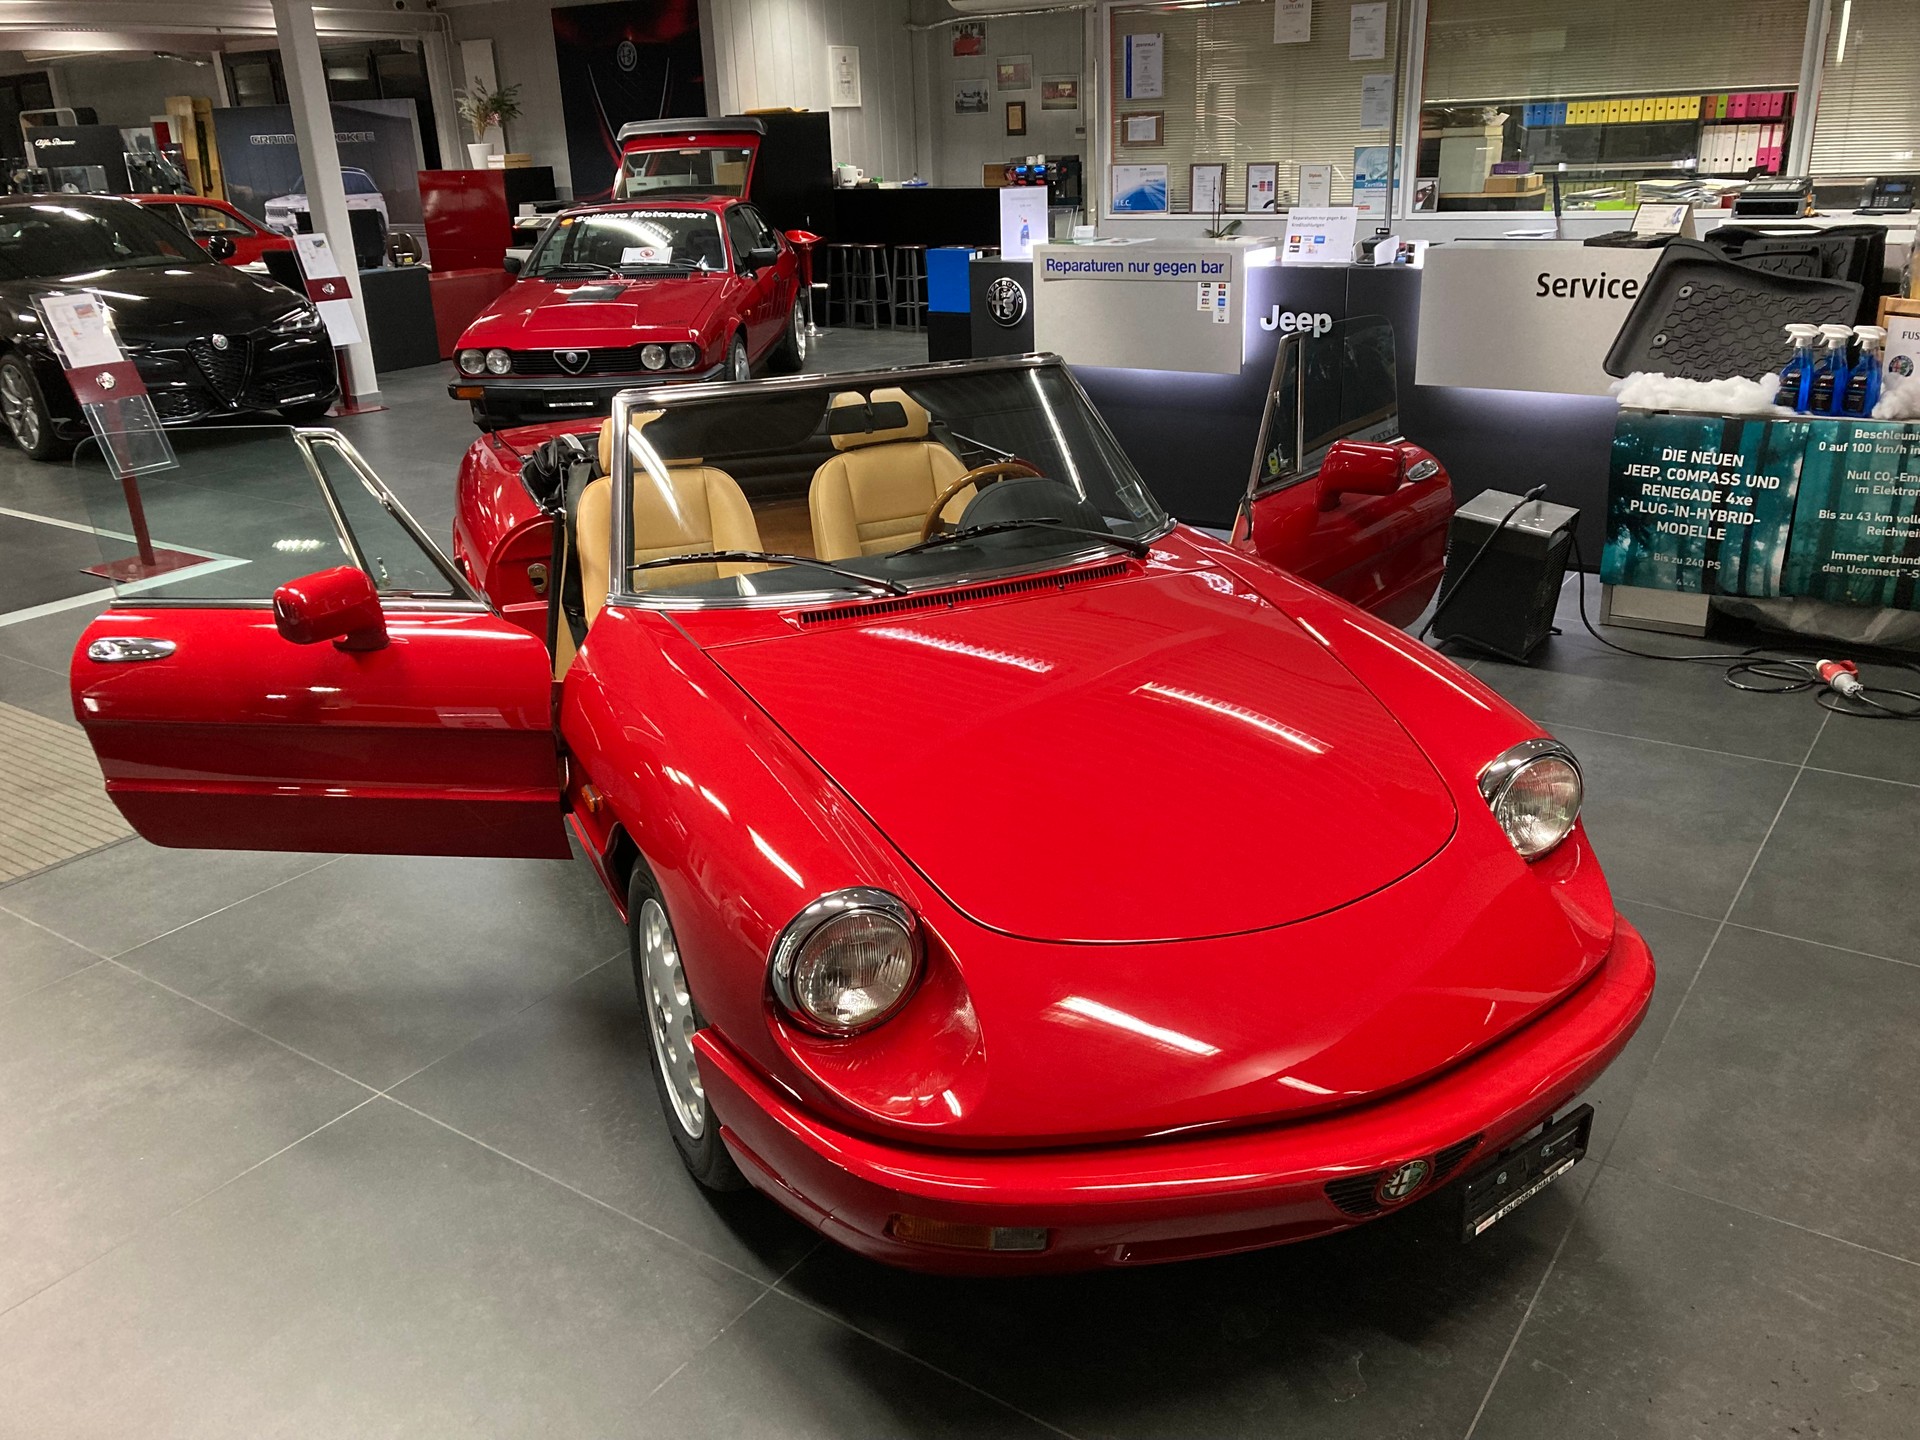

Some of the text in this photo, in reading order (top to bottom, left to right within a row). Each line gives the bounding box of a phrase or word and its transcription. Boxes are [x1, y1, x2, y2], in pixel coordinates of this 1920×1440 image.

[250, 132, 375, 145] GRAND OKEE
[631, 211, 708, 219] Motorsport
[1046, 258, 1224, 276] Reparaturen nur gegen bar
[1002, 280, 1022, 304] ROMEO
[1536, 272, 1638, 299] Service
[1260, 305, 1332, 337] Jeep
[1854, 429, 1920, 442] Beschleuni
[1819, 442, 1826, 451] 0
[1829, 443, 1848, 452] auf
[1852, 443, 1872, 452] 100
[1876, 444, 1907, 454] km/h
[1662, 448, 1744, 467] DIE NEUEN
[1667, 468, 1741, 486] COMPASS
[1746, 475, 1780, 489] UND
[1847, 471, 1870, 480] Null
[1642, 484, 1753, 506] RENEGADE 4xe
[1855, 486, 1869, 494] im
[1630, 500, 1761, 525] PLUG-IN-HYBRID-
[1819, 510, 1836, 520] Bis
[1856, 512, 1871, 521] 43
[1875, 512, 1892, 523] km
[1656, 521, 1727, 540] MODELLE
[1867, 526, 1920, 538] Reichwei
[1654, 553, 1668, 562] Bis
[1686, 557, 1704, 568] 240
[1707, 560, 1721, 570] PS
[1831, 551, 1920, 565] Immer verbund
[1822, 564, 1843, 573] den
